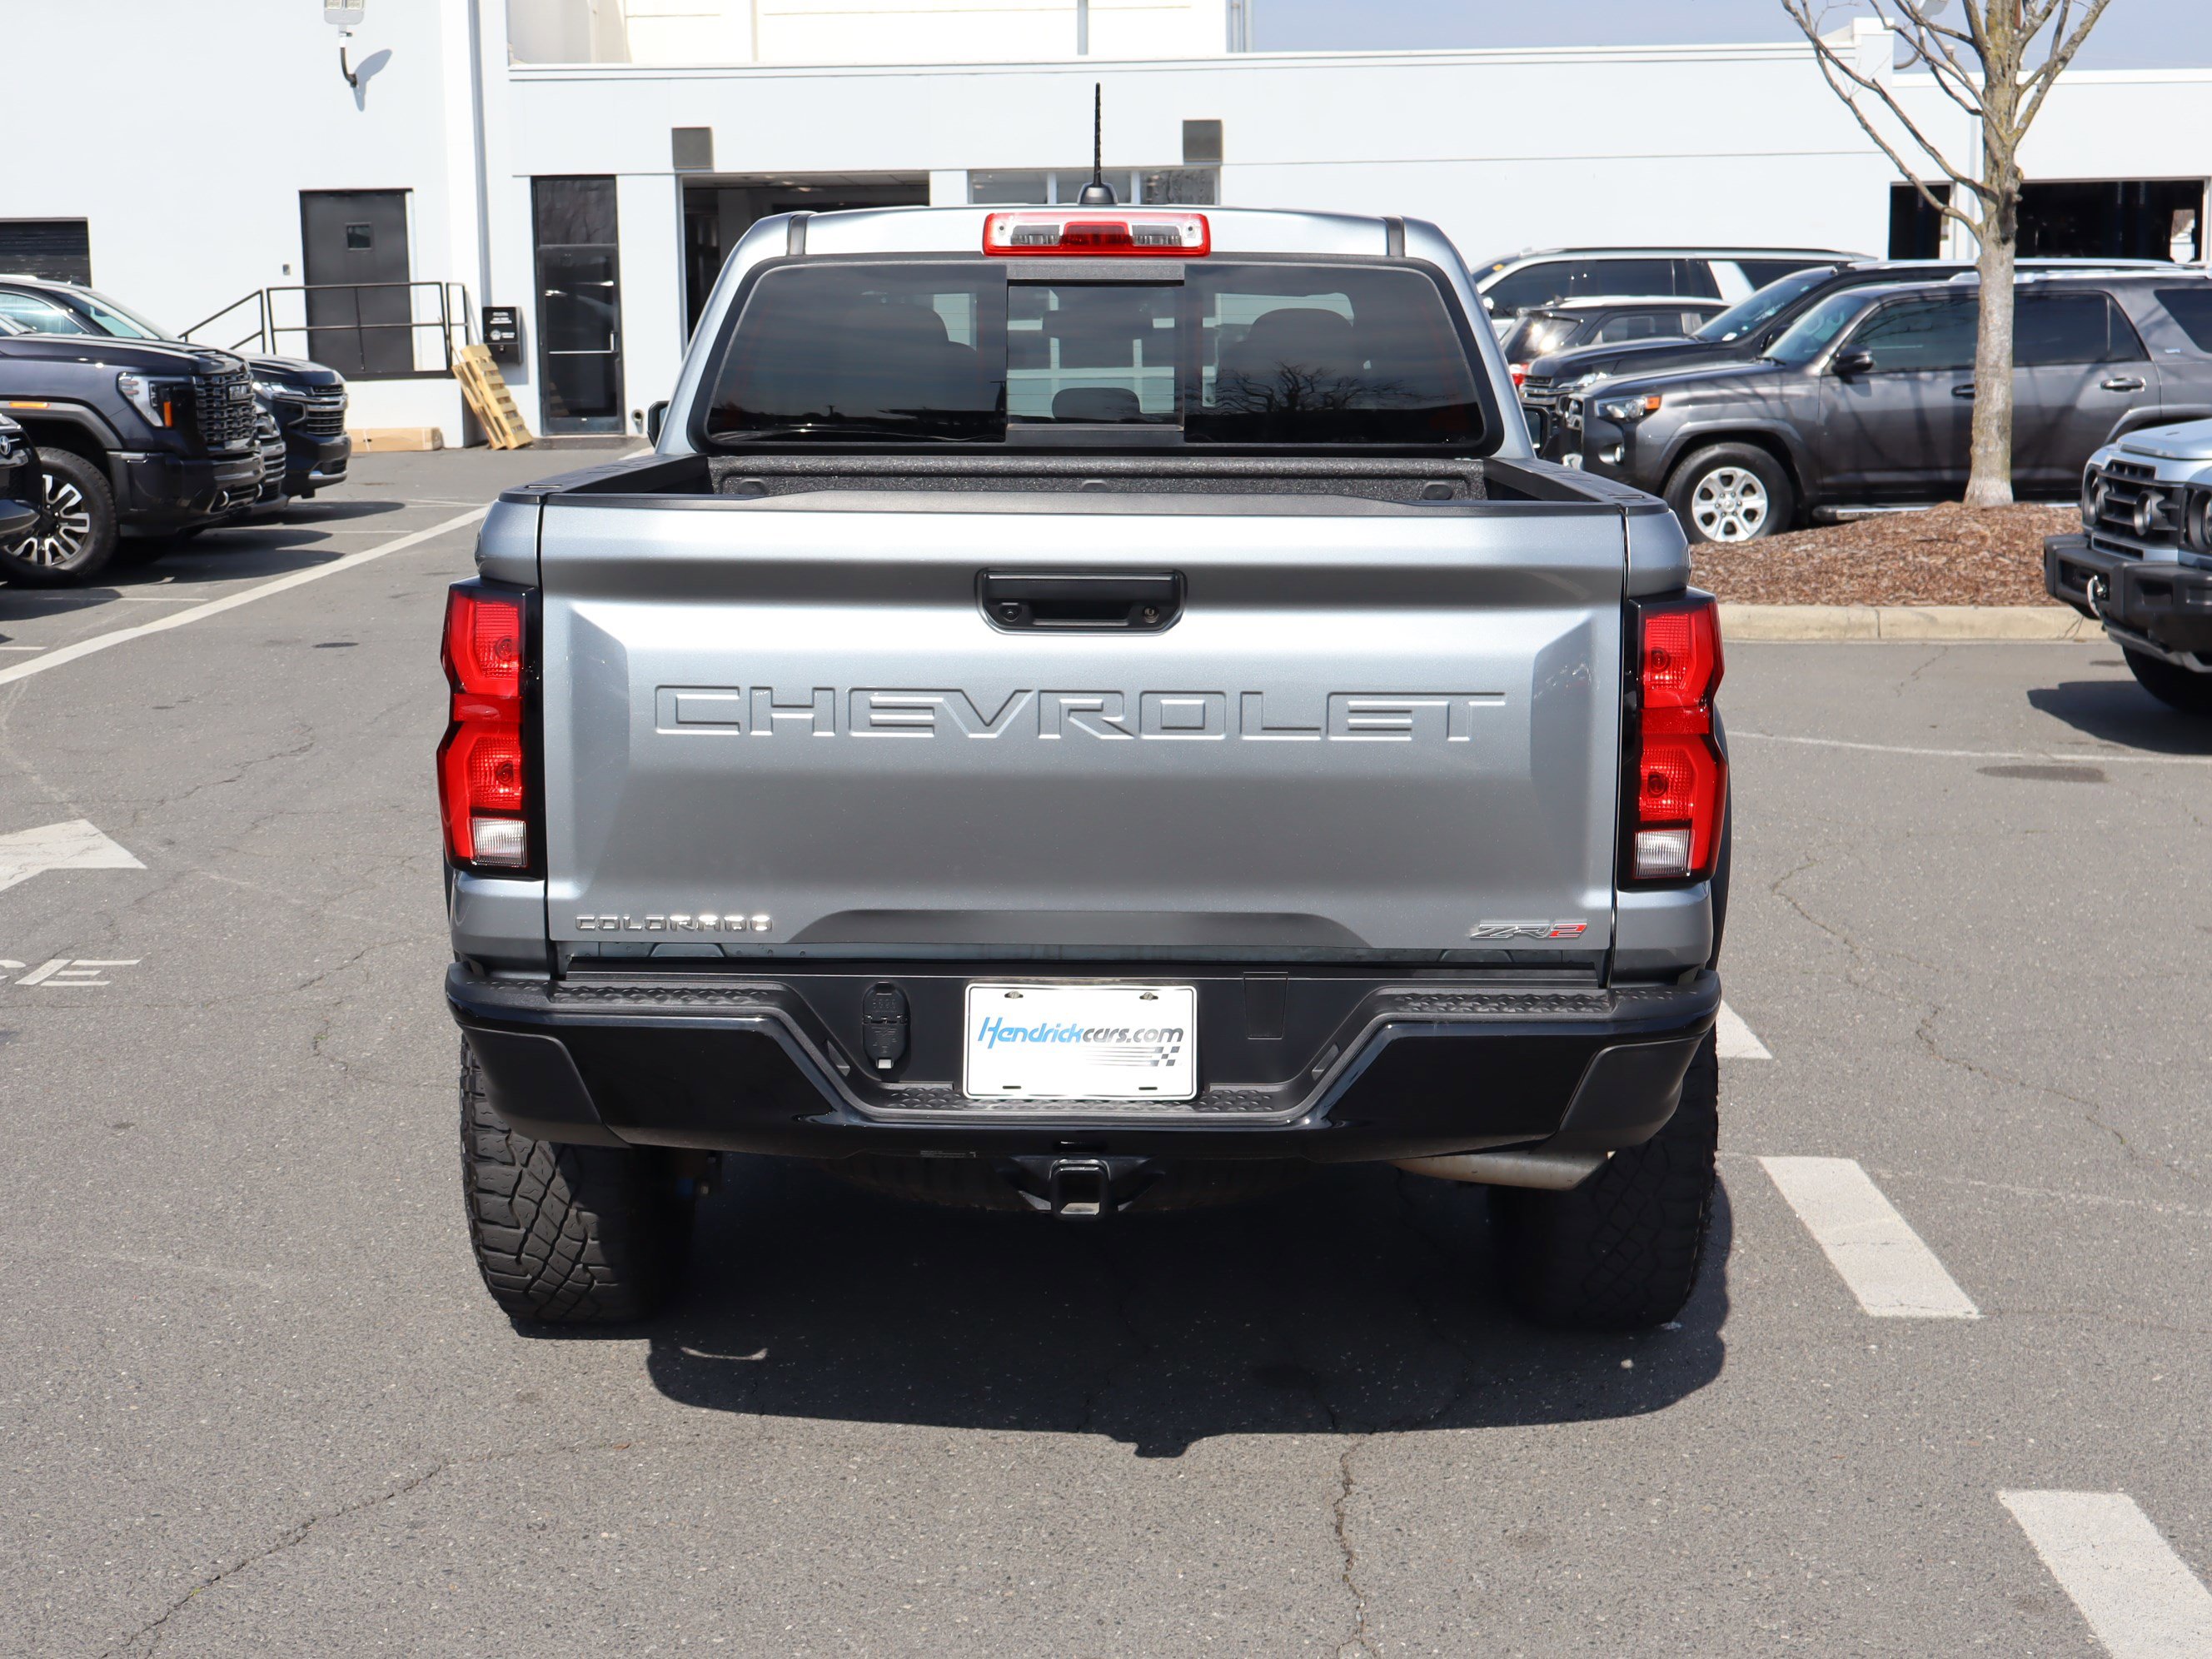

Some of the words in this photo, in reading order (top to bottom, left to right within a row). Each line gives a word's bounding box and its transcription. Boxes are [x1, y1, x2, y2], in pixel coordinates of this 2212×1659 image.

[655, 685, 1505, 741] CHEVROLET
[575, 914, 772, 931] COLORADO
[1470, 921, 1587, 939] ZR2
[978, 1017, 1184, 1049] Hendrickcars.com
